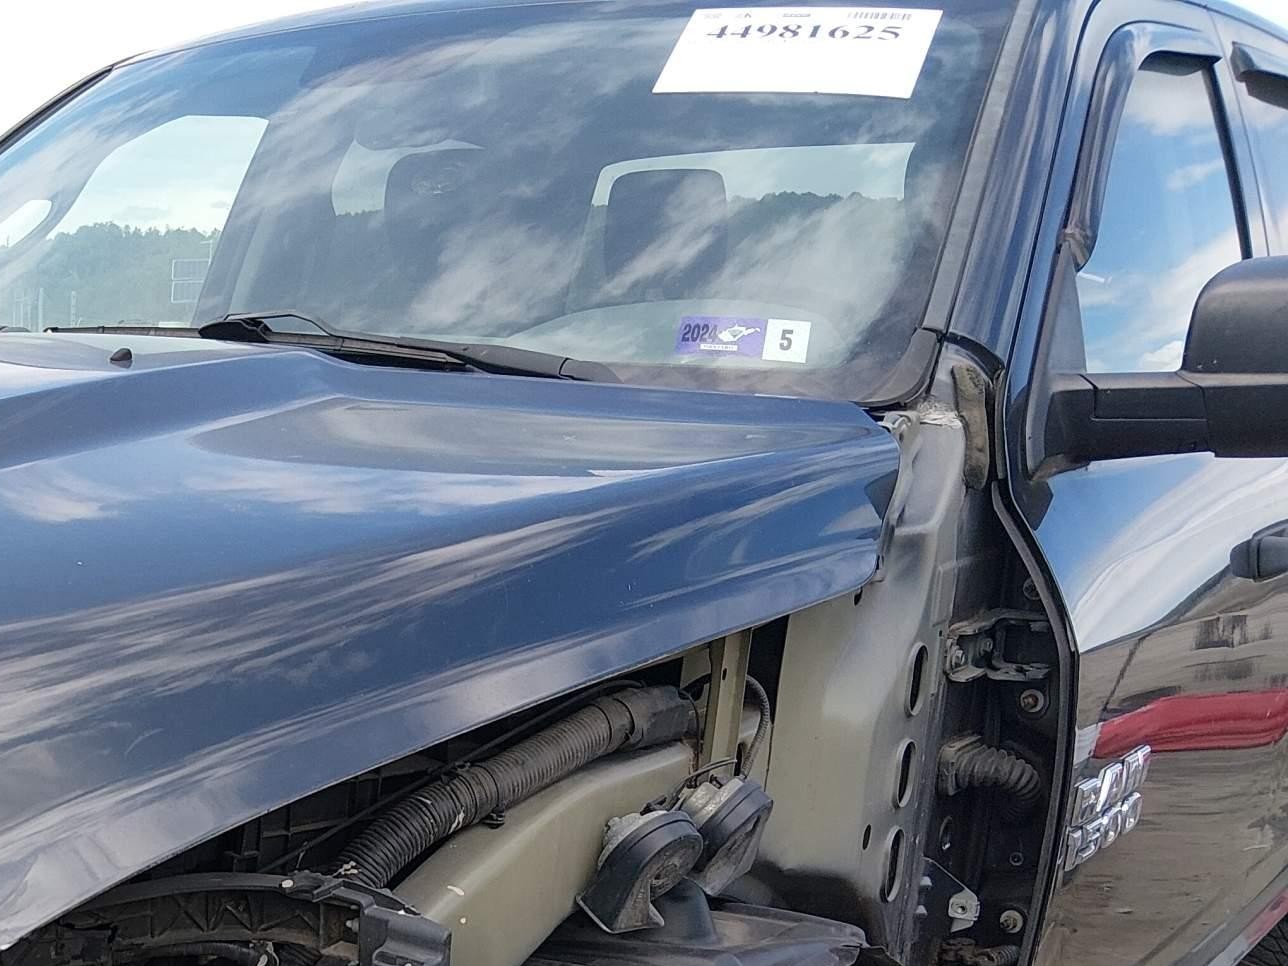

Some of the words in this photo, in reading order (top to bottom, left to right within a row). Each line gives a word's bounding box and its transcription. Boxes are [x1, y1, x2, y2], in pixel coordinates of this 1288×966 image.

[706, 24, 903, 41] 44981625
[681, 323, 718, 343] 2024
[778, 328, 794, 351] 5
